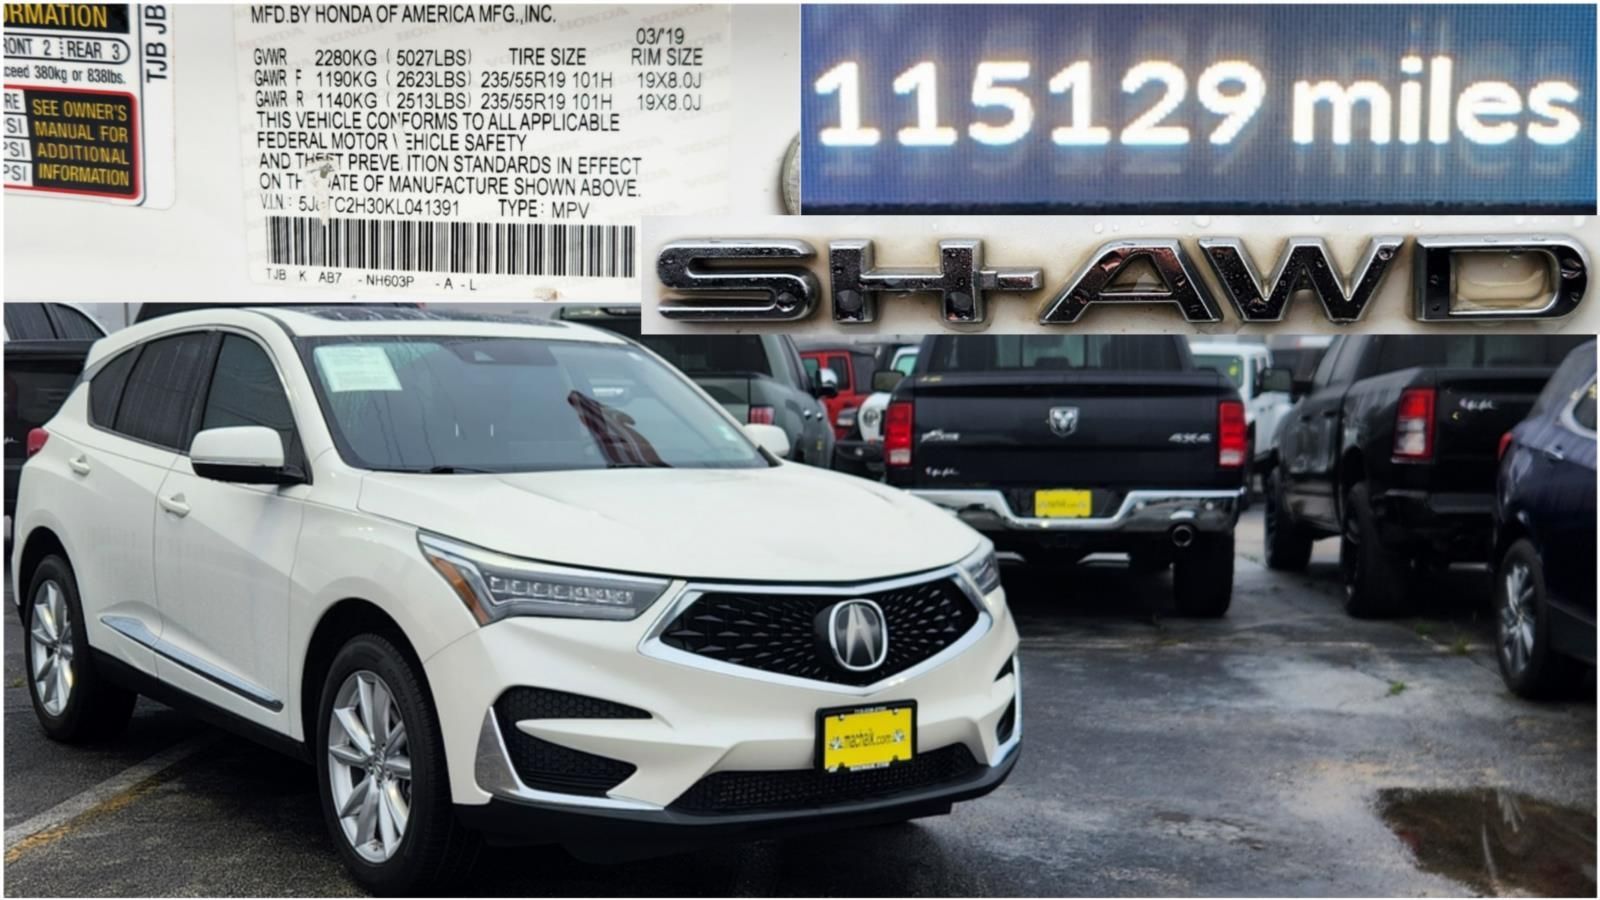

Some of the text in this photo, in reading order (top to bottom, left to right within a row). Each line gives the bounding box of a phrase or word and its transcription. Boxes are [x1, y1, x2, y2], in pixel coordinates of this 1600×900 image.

[251, 5, 311, 24] MFD.BY
[315, 5, 373, 24] HONDA
[376, 5, 398, 24] OF
[401, 5, 475, 24] AMERICA
[43, 39, 52, 56] 2
[67, 40, 121, 60] REAR 3
[253, 48, 287, 66] GVWR
[314, 49, 377, 67] 2280KG
[508, 48, 545, 66] TIRE
[550, 48, 587, 66] SIZE
[631, 48, 661, 66] RIM
[666, 48, 703, 66] SIZE
[145, 42, 168, 83] TJB
[35, 65, 67, 83] 380kg
[72, 69, 82, 81] or
[87, 67, 126, 84] 838lbs.
[254, 69, 287, 87] GAWR
[296, 69, 302, 86] F
[316, 71, 377, 88] 1190KG
[480, 71, 566, 89] 235/55R19
[572, 71, 612, 89] 101H
[637, 71, 702, 89] 19X8.0J
[32, 98, 128, 122] SEE OWNER'S
[255, 90, 288, 108] GAWR
[297, 90, 304, 108] R
[316, 92, 377, 109] 1140KG
[480, 93, 566, 110] 235/55R19
[572, 93, 612, 110] 101H
[637, 93, 702, 111] 19X8.0J
[813, 54, 1581, 147] 115129 miles
[256, 111, 291, 128] THIS
[296, 111, 362, 129] VEHICLE
[463, 112, 484, 131] TO
[488, 112, 517, 131] ALL
[520, 113, 620, 131] APPLICABLE
[34, 121, 129, 143] MANUAL FOR
[257, 131, 328, 149] FEDERAL
[332, 132, 388, 150] MOTOR
[465, 133, 527, 152] SAFETY
[37, 142, 130, 165] ADDITIONAL
[260, 152, 291, 169] AND
[454, 155, 552, 174] STANDARDS
[557, 156, 572, 174] IN
[578, 157, 642, 175] EFFECT
[38, 163, 129, 187] INFORMATION
[260, 172, 281, 189] ON
[327, 174, 359, 191] ATE
[363, 174, 385, 192] OF
[389, 175, 509, 194] MANUFACTURE
[514, 177, 576, 196] SHOWN
[580, 178, 641, 197] ABOVE.
[552, 201, 590, 219] MPV
[266, 268, 286, 281] TJB
[299, 270, 307, 281] K
[318, 271, 342, 284] AB7
